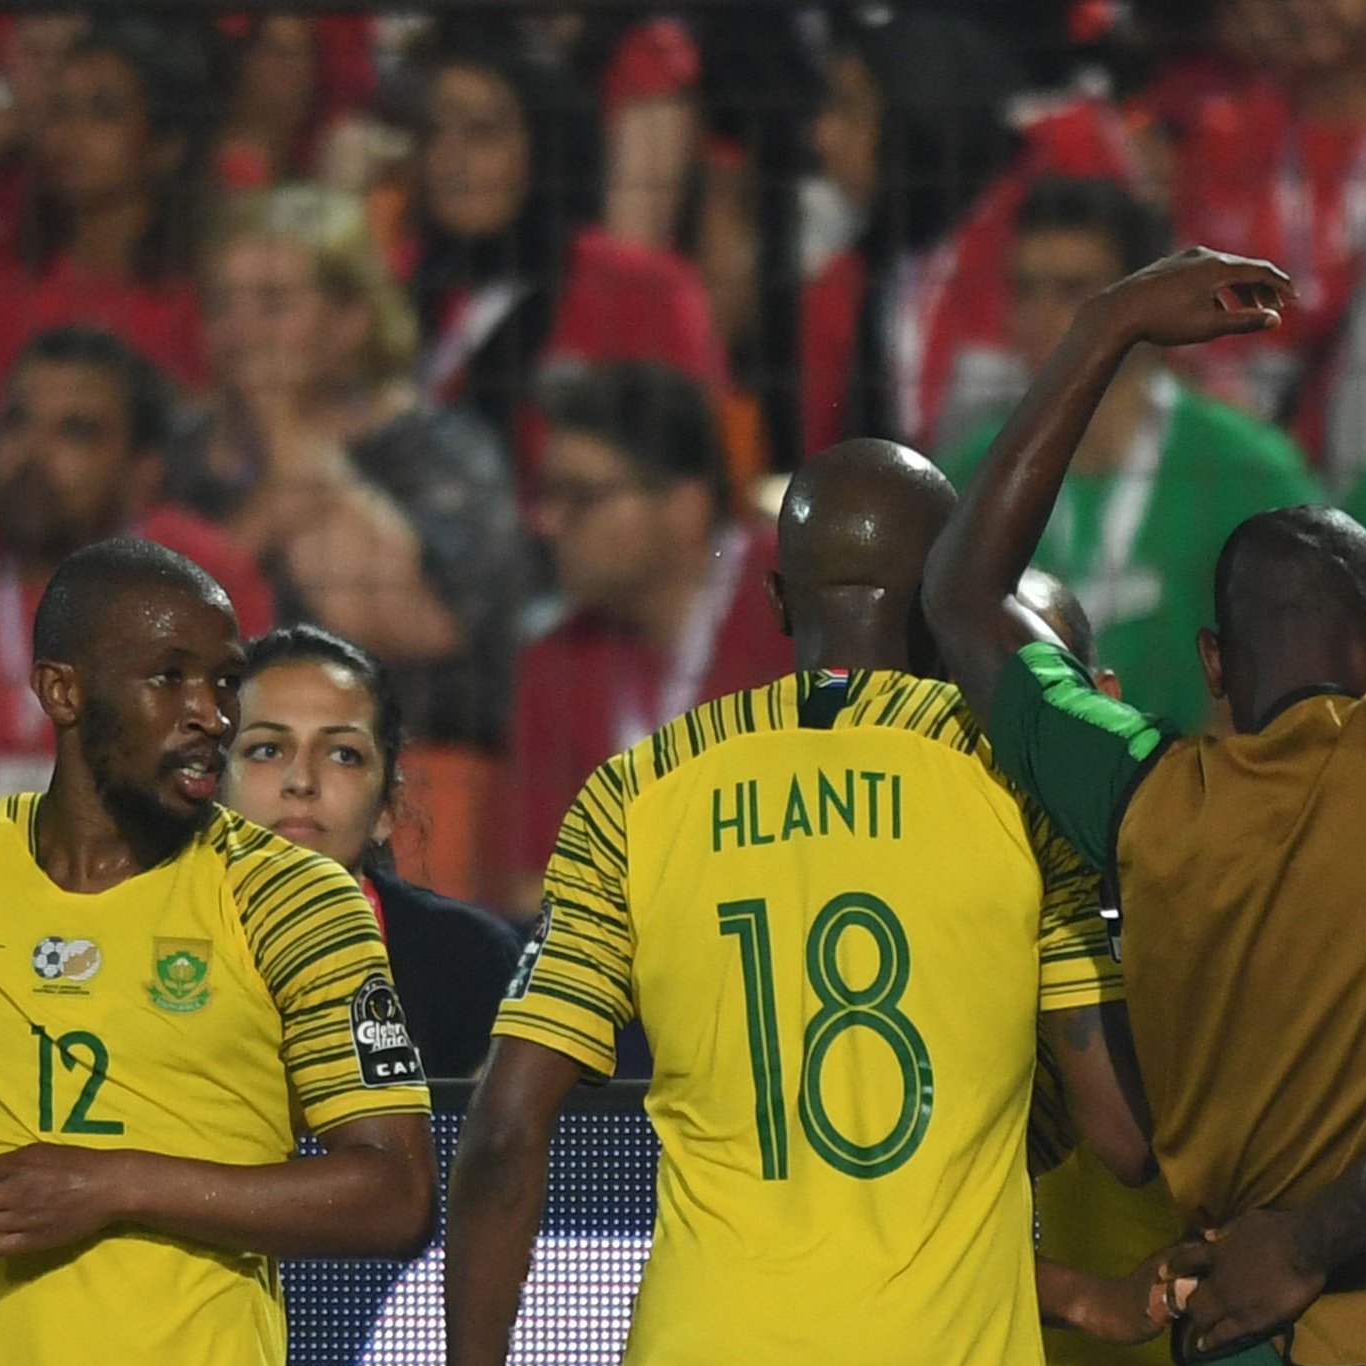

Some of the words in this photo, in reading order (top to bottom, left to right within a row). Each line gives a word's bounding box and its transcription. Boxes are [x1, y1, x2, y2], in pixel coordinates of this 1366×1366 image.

[711, 767, 902, 852] HLANTI
[31, 1023, 125, 1135] 12
[717, 891, 934, 1181] 18
